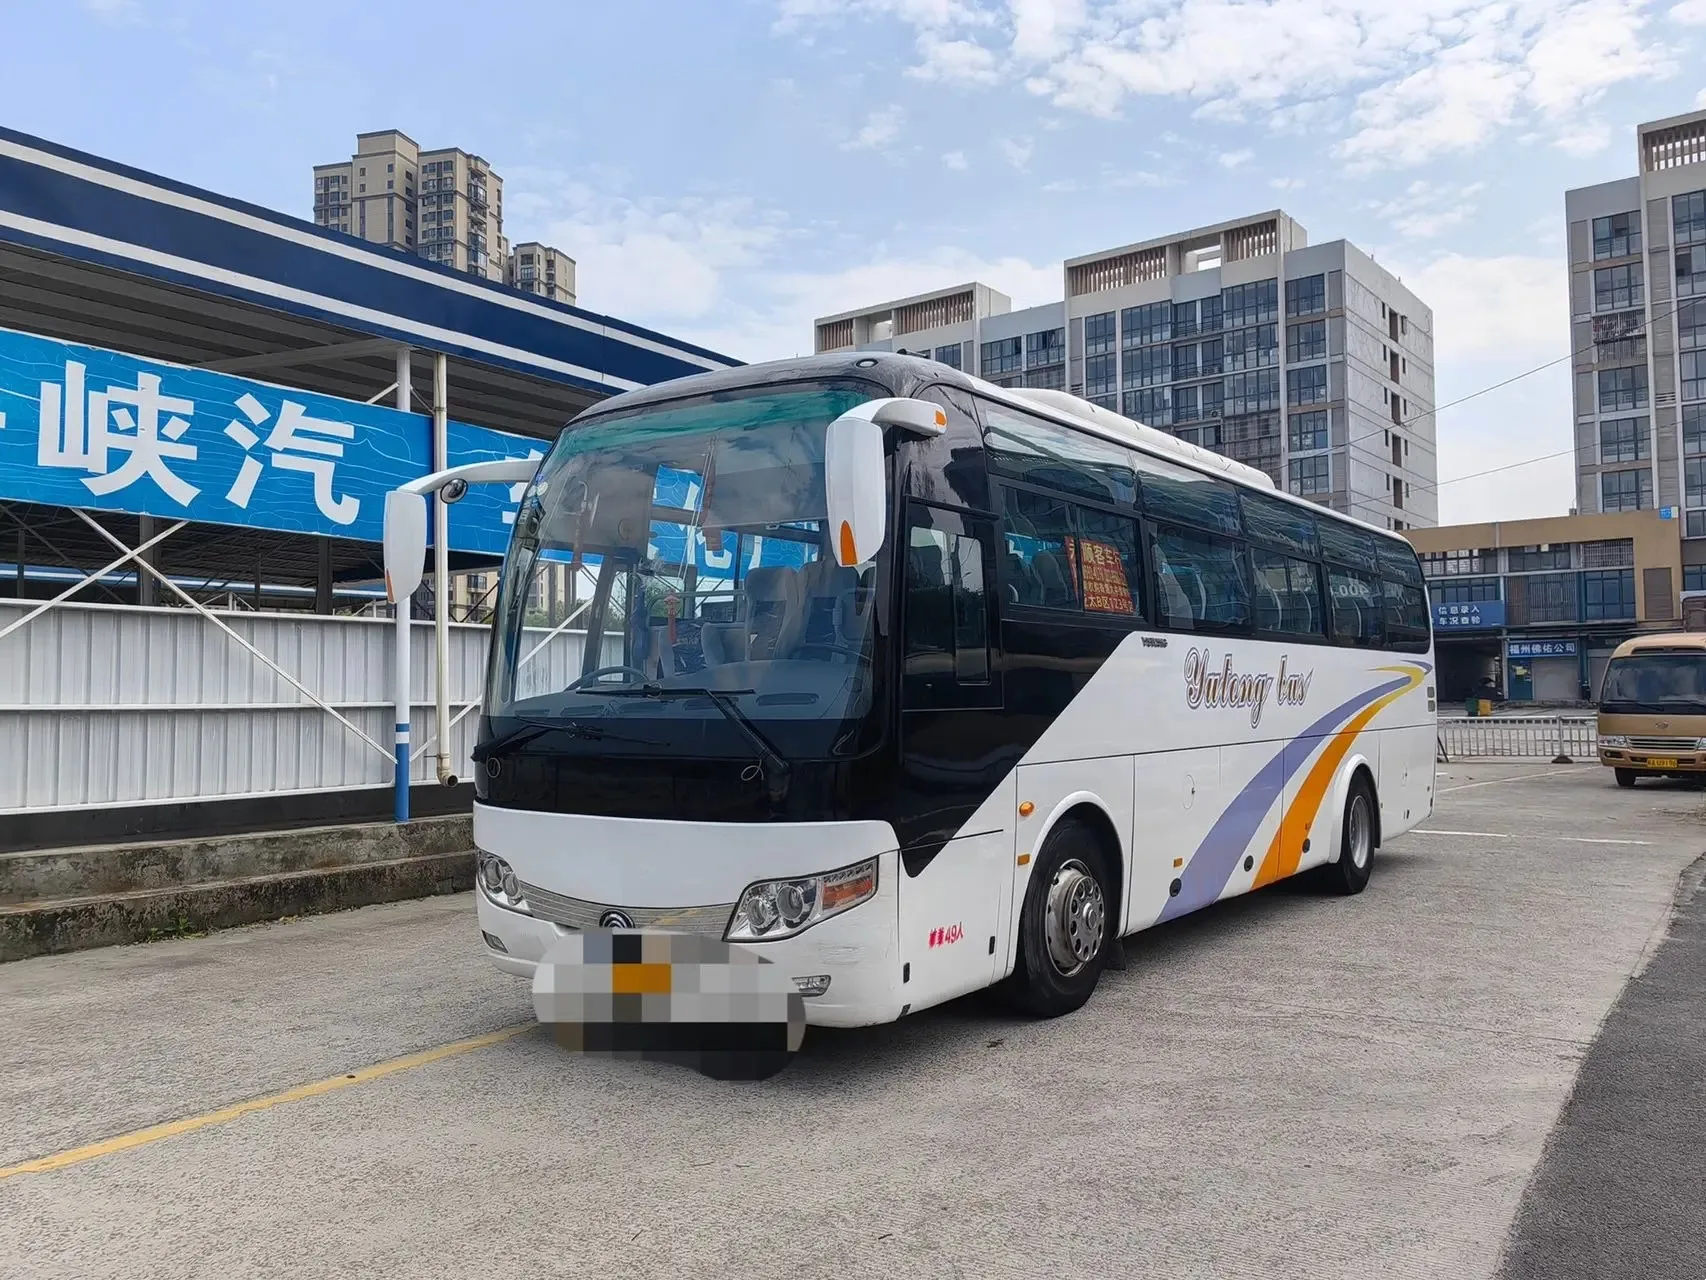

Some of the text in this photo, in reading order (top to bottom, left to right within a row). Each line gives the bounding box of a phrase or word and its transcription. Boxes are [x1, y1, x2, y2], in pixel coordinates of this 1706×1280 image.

[1438, 605, 1480, 614] 信息录入
[1184, 647, 1315, 729] Yutong bus
